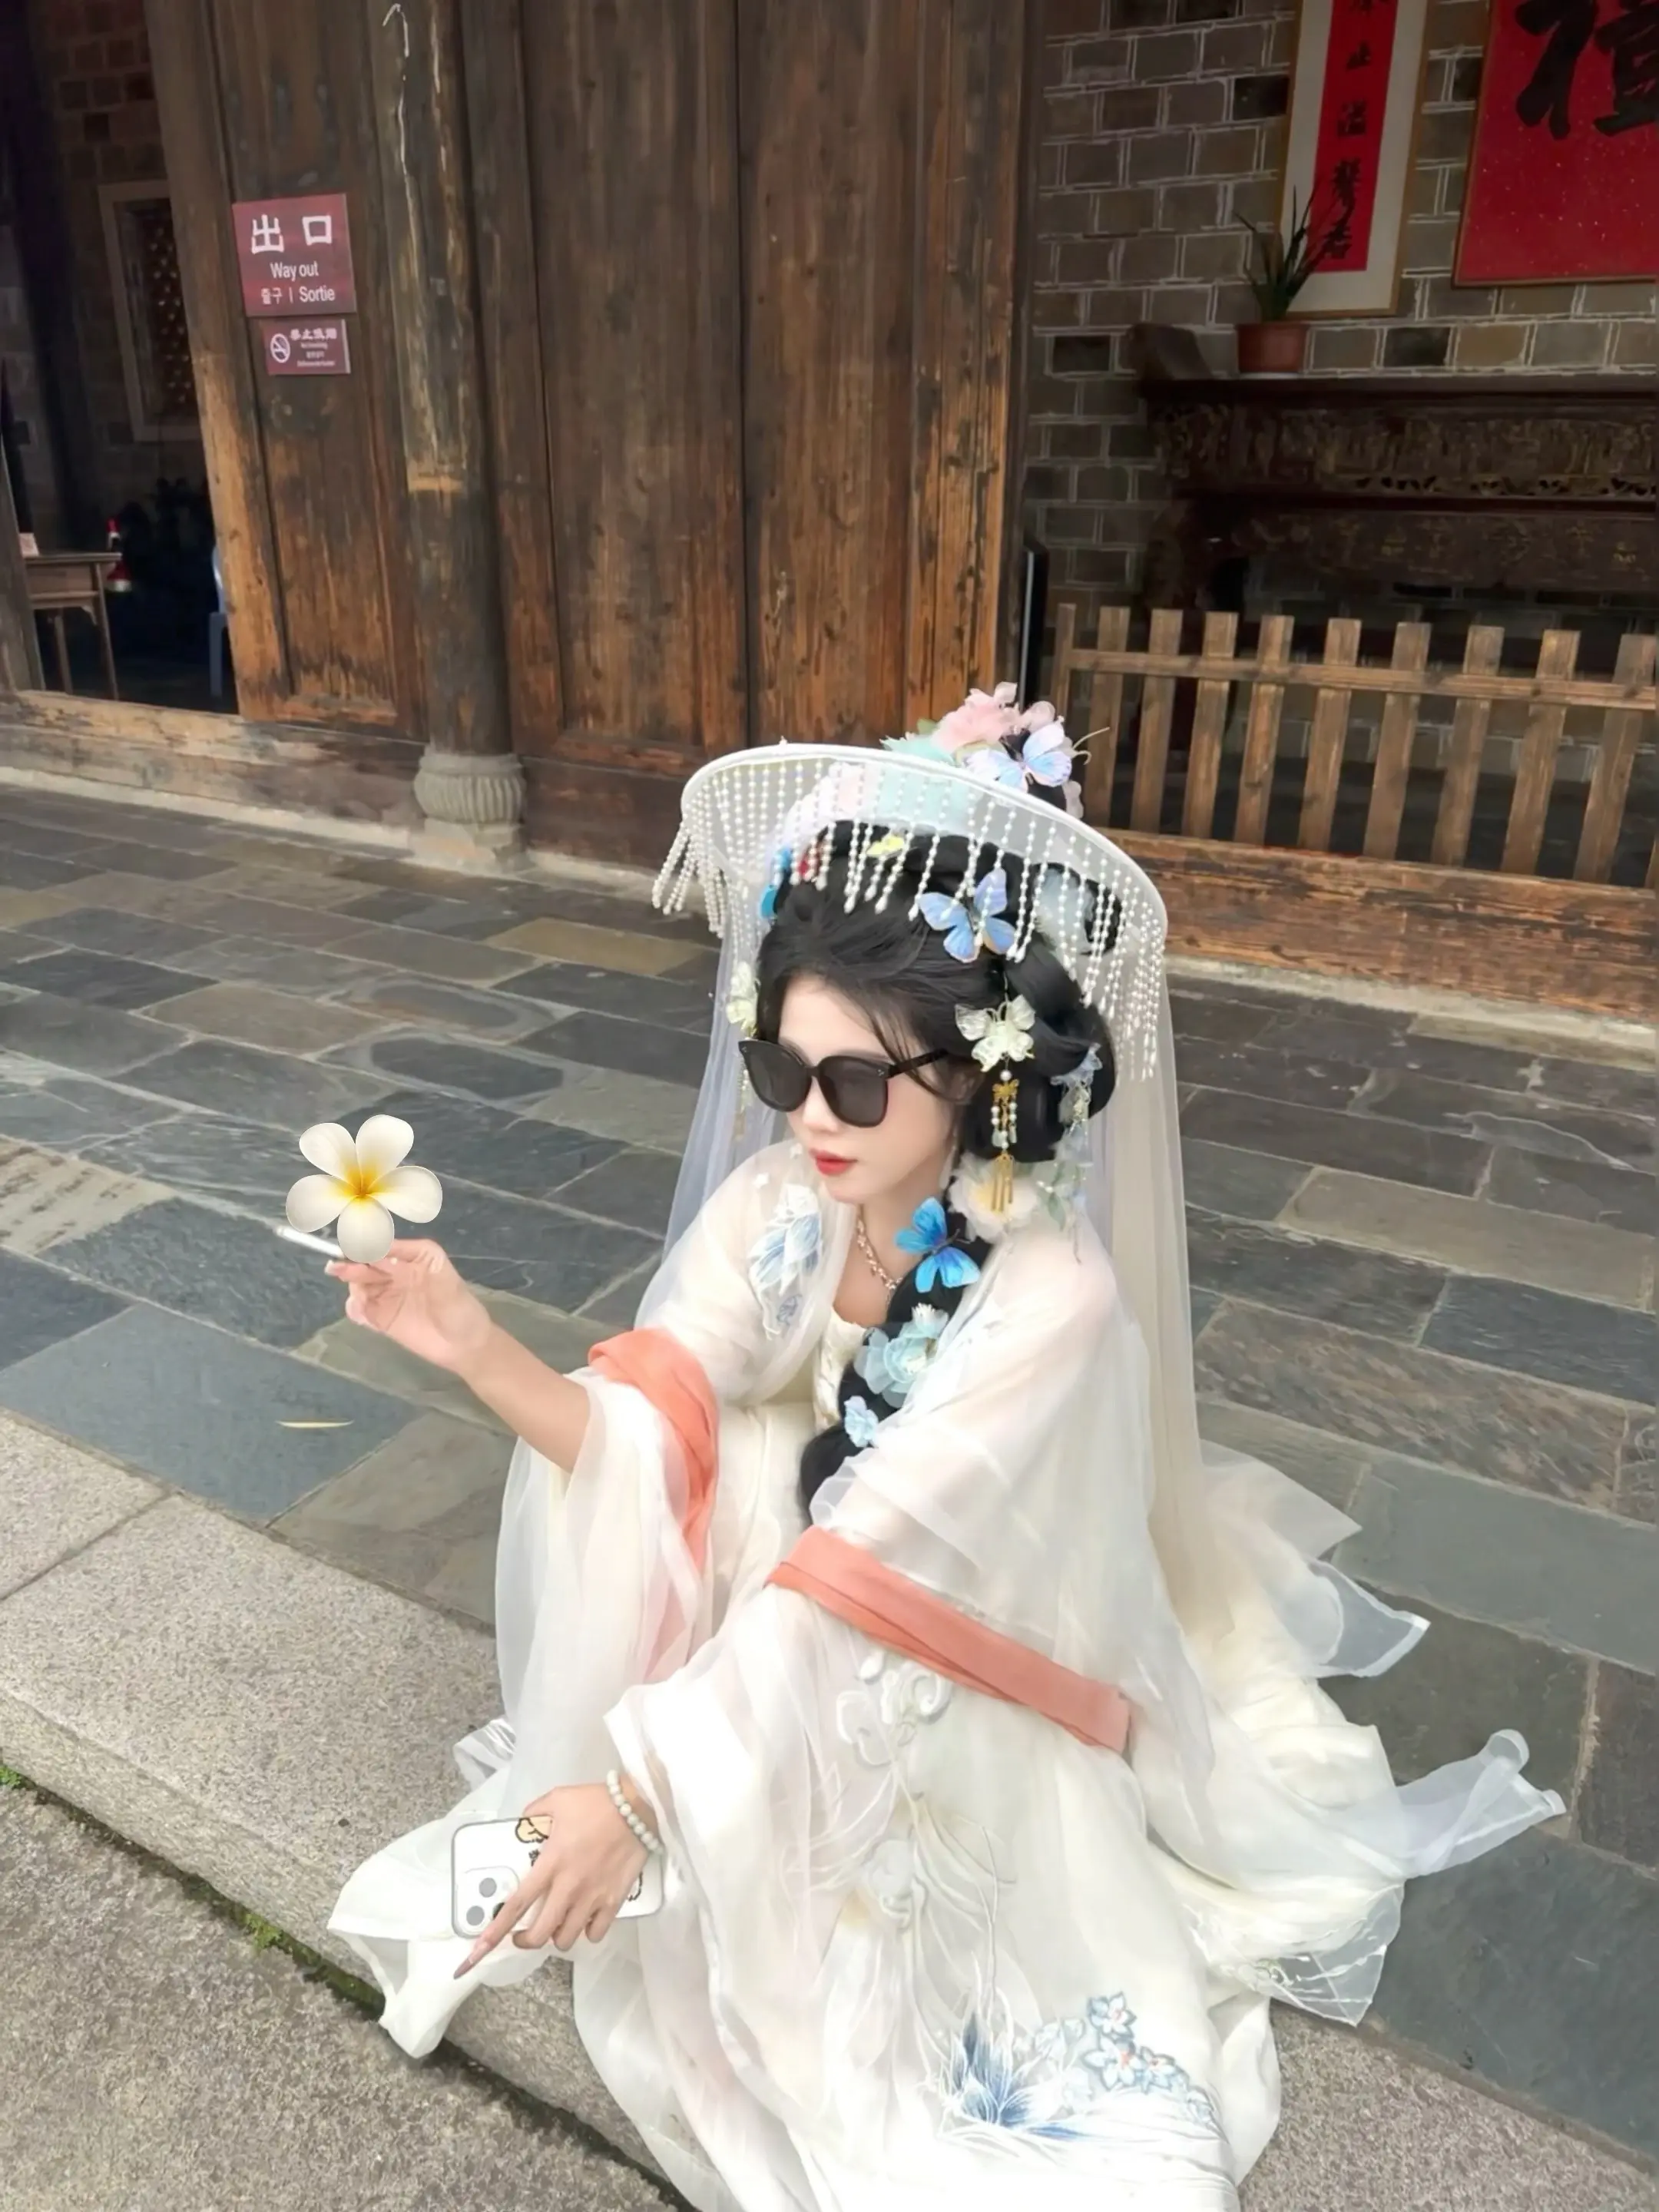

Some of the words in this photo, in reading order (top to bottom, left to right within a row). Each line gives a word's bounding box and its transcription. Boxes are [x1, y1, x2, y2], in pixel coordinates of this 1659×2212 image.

[251, 214, 333, 254] 出口
[270, 261, 297, 282] Way
[299, 260, 320, 277] out
[299, 285, 336, 302] Sortie
